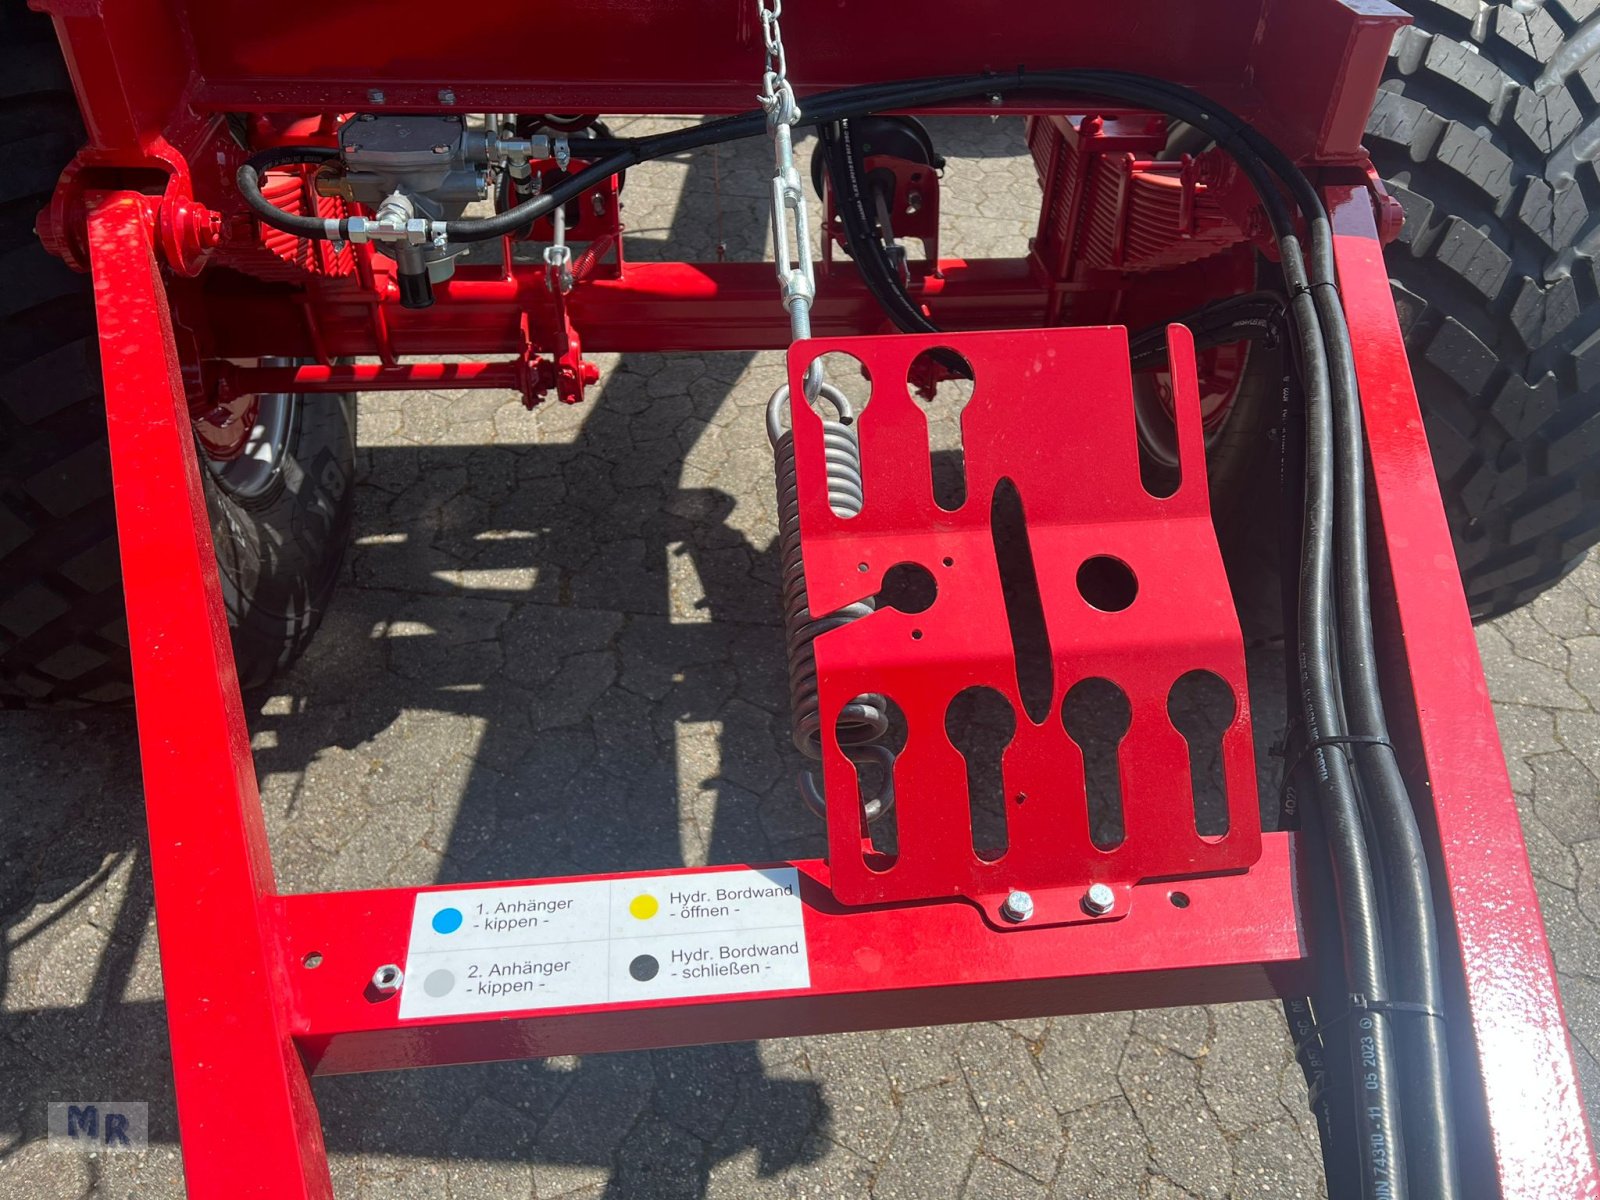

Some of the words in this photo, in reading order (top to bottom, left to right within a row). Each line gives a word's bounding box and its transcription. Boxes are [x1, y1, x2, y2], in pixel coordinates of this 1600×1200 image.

[1314, 747, 1329, 782] WABCO
[670, 890, 711, 906] Hydr.
[716, 884, 793, 901] Bordwand
[476, 903, 489, 915] 1.
[494, 899, 574, 914] Anhänger
[681, 905, 729, 919] öffnen
[485, 917, 538, 932] kippen
[671, 947, 714, 965] Hydr.
[719, 941, 799, 959] Bordwand
[467, 964, 483, 978] 2.
[488, 961, 571, 977] Anhänger
[682, 961, 760, 979] schließen
[478, 980, 533, 997] kippen
[1360, 1036, 1376, 1067] 2023
[1365, 1073, 1379, 1090] 05
[1368, 1106, 1381, 1120] 11
[1371, 1133, 1388, 1176] 74310
